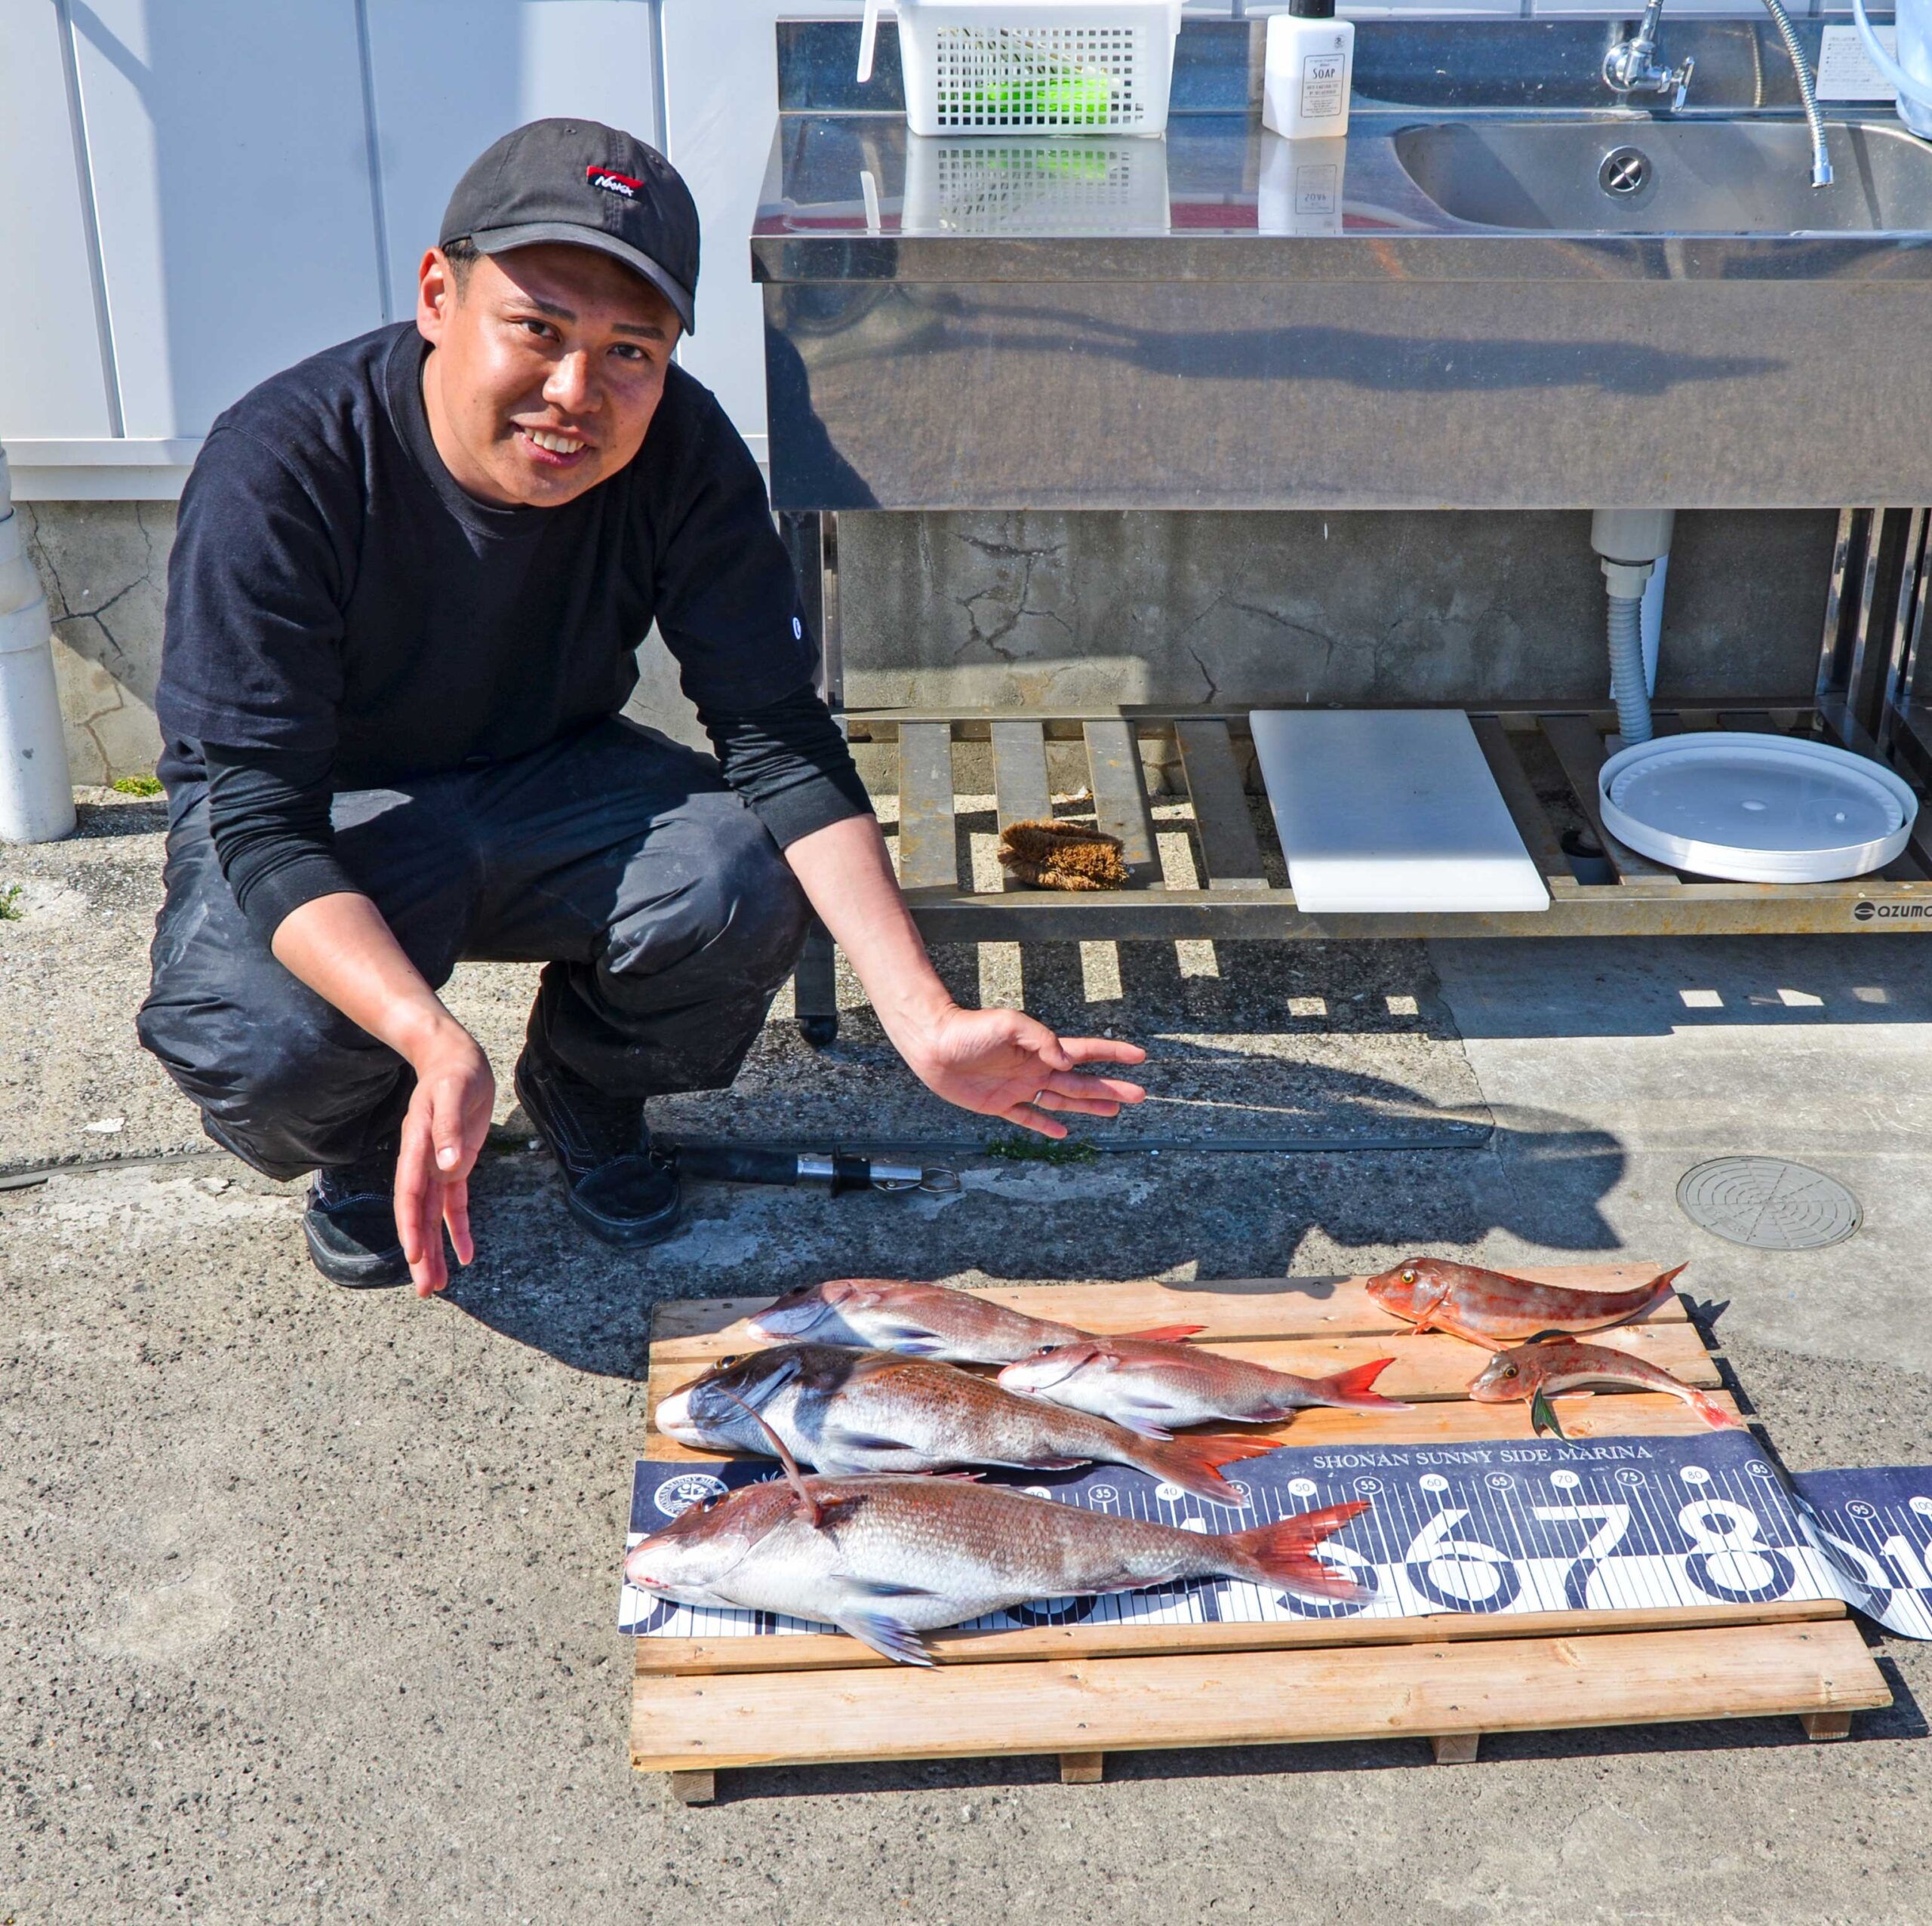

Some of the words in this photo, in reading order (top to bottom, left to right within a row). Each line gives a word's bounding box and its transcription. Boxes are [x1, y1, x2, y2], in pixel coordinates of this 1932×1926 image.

[1313, 68, 1335, 78] SOAP
[1313, 1453, 1409, 1469] SHONAN
[1416, 1450, 1492, 1466] SUNNY
[1500, 1449, 1552, 1463] SIDE
[1556, 1445, 1653, 1461] MARINA
[1095, 1488, 1111, 1499] 35
[1163, 1487, 1178, 1496] 40
[1295, 1483, 1310, 1492] 50
[1360, 1481, 1377, 1491] 55
[1426, 1478, 1442, 1487] 60
[1491, 1476, 1508, 1486] 65
[1557, 1475, 1573, 1484] 70
[1622, 1472, 1638, 1481] 75
[1687, 1471, 1703, 1480] 80
[1752, 1463, 1768, 1474] 85
[1852, 1504, 1869, 1515] 95
[1913, 1501, 1932, 1510] 100
[1405, 1509, 1521, 1614] 6
[1532, 1504, 1630, 1610] 7
[1678, 1499, 1795, 1604] 8
